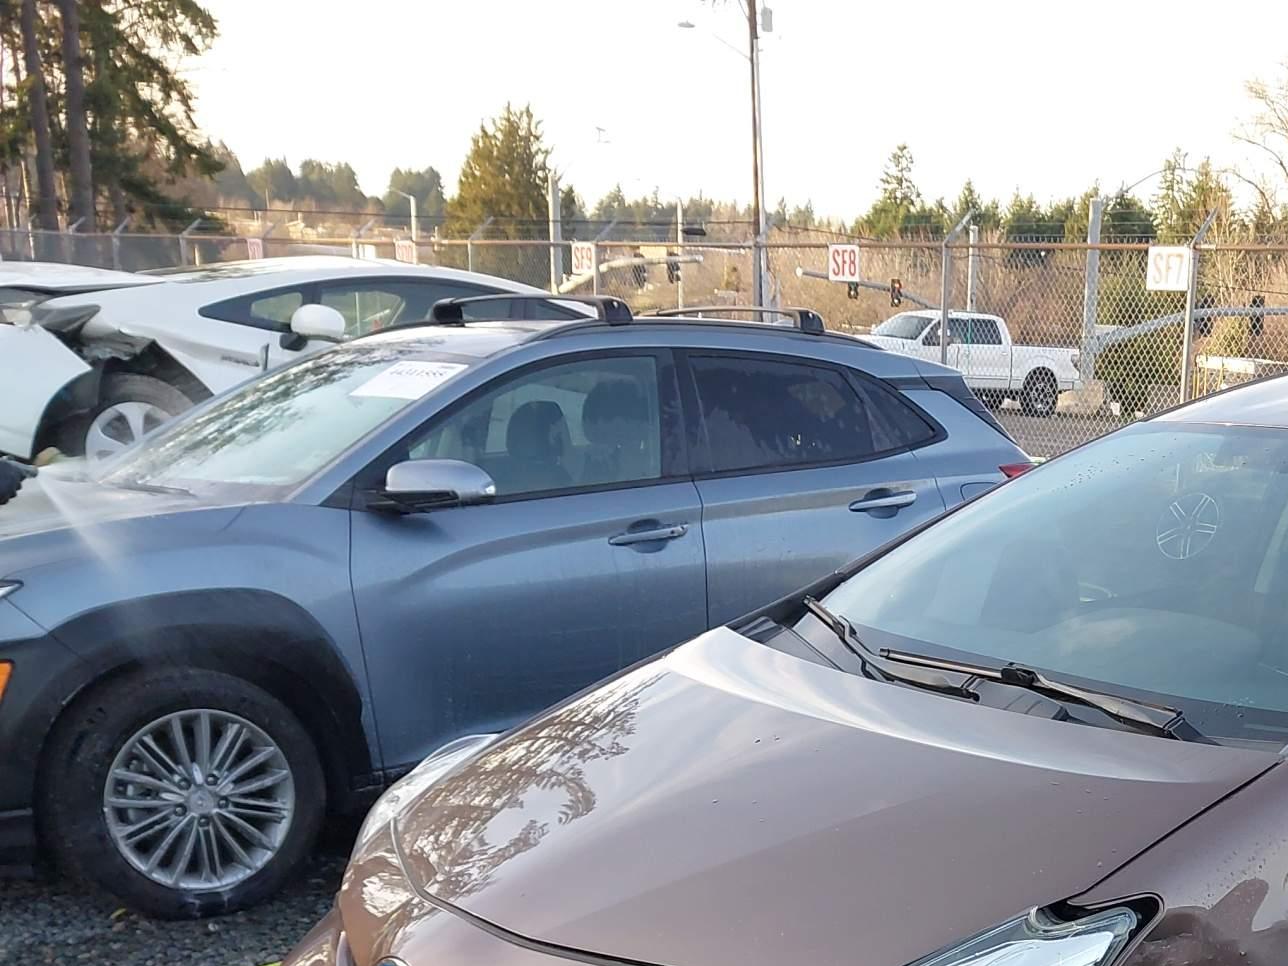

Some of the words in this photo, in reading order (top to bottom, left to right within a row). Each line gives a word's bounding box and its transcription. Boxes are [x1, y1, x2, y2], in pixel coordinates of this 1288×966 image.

[573, 246, 592, 269] SF9
[832, 249, 857, 276] SF8
[1152, 252, 1185, 284] SF7
